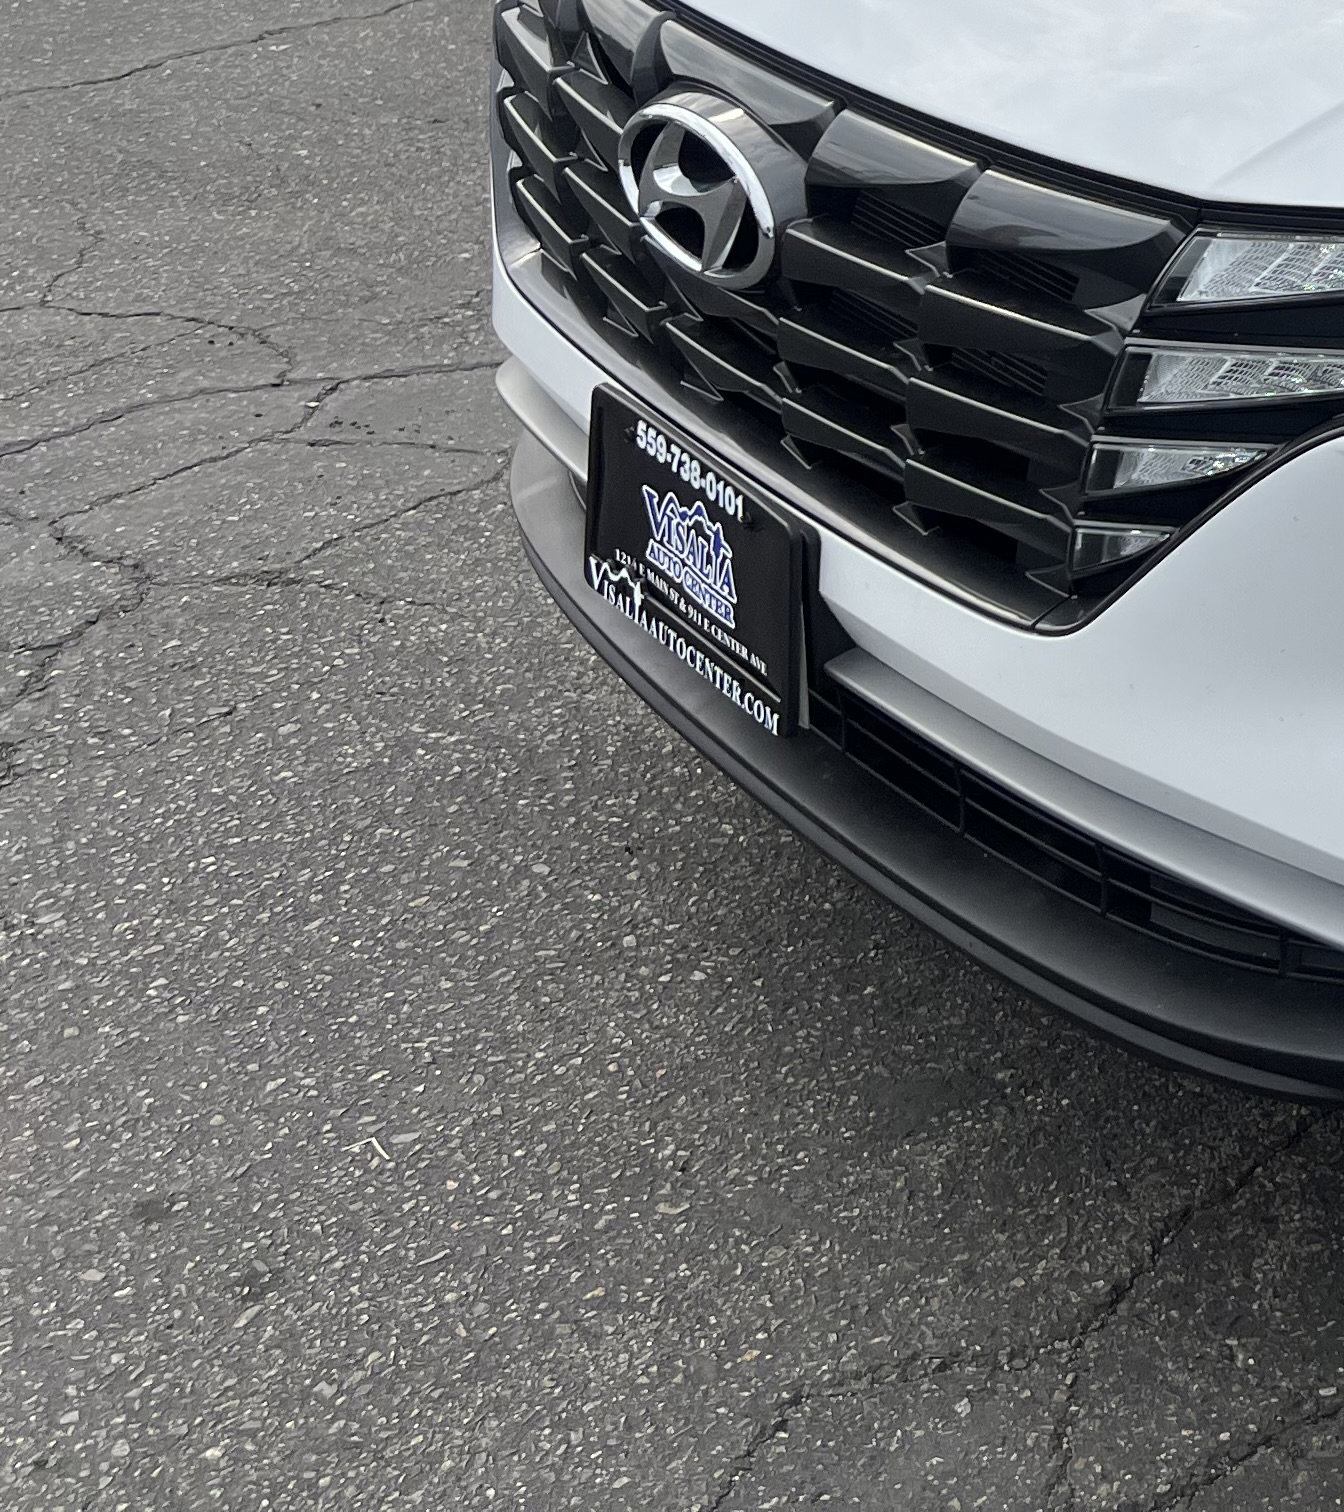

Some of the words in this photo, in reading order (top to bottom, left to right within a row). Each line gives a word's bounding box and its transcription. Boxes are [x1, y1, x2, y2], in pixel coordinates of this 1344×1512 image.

[636, 419, 745, 524] 559-738-0101
[641, 484, 738, 605] VISALIA
[647, 539, 683, 585] AUTO
[684, 565, 736, 629] CENTER
[590, 555, 781, 737] VISALIAAUTOCENTER.COM
[647, 567, 669, 596] MAIN
[669, 587, 680, 606] ST
[679, 596, 687, 614] &
[687, 604, 702, 627] 911
[703, 617, 710, 633] E
[710, 624, 749, 661] CENTER
